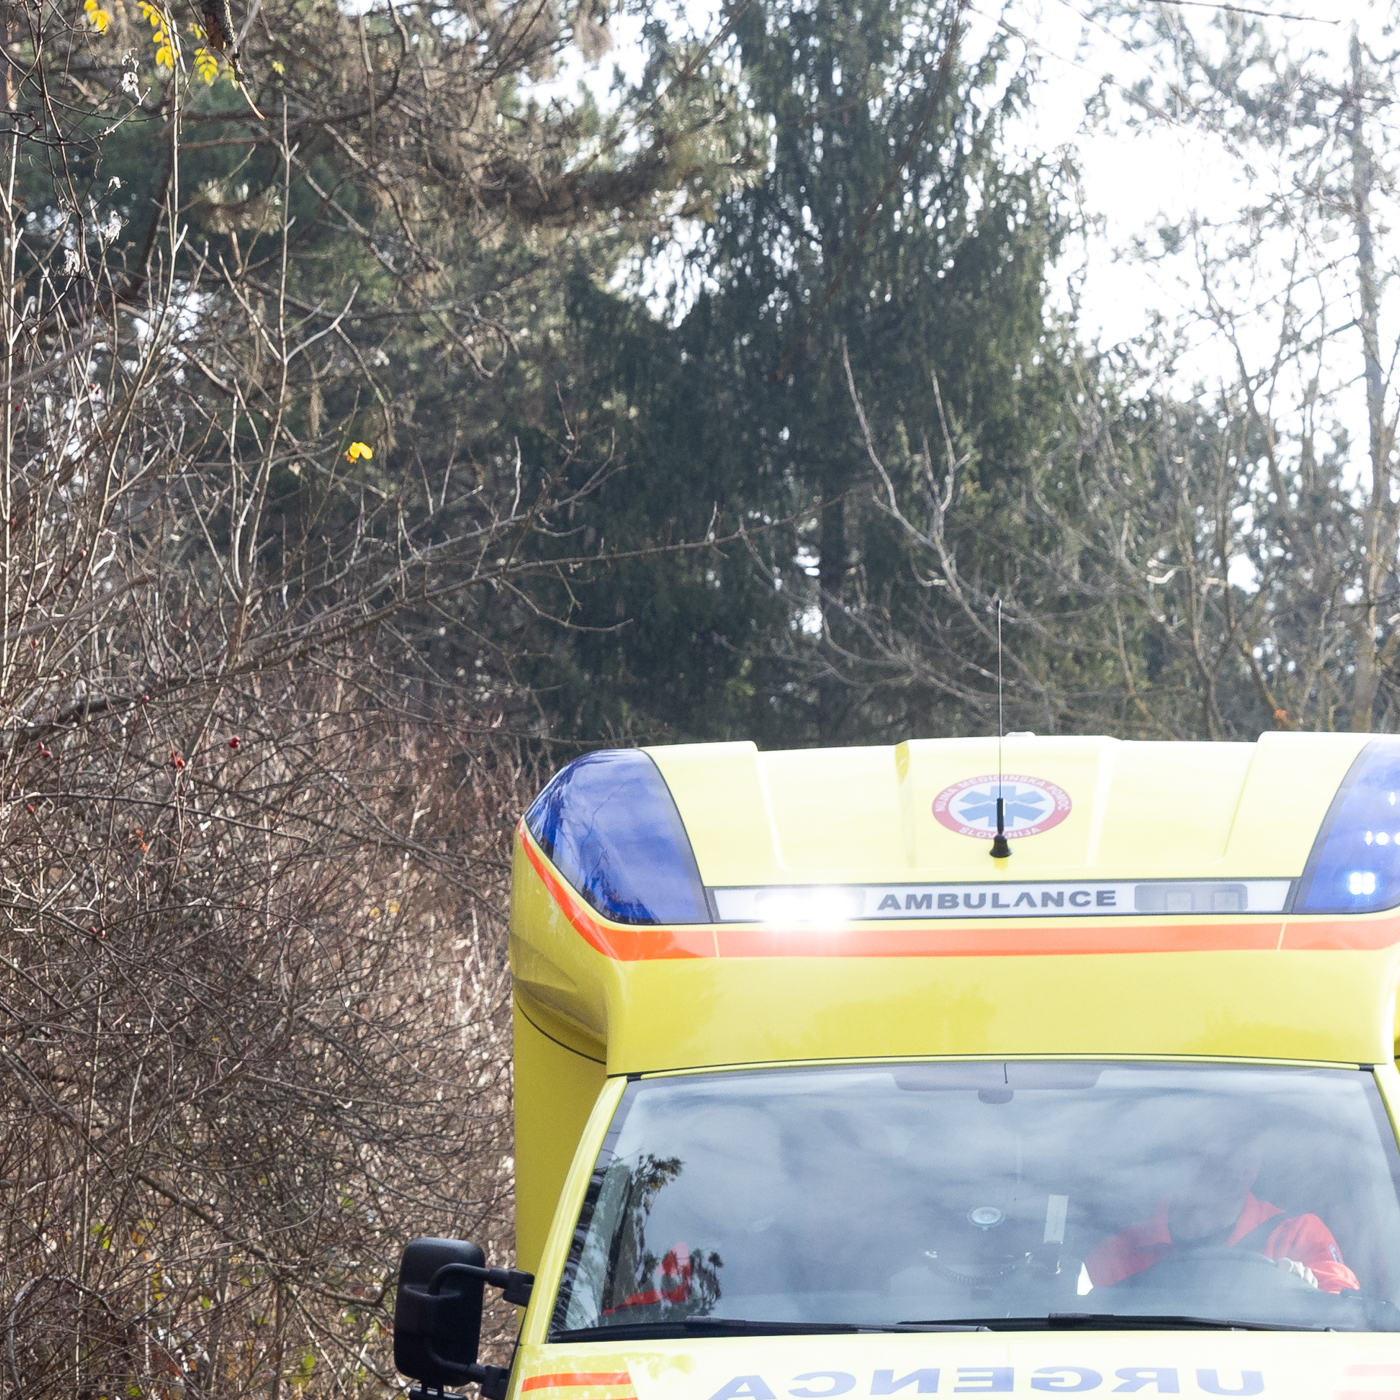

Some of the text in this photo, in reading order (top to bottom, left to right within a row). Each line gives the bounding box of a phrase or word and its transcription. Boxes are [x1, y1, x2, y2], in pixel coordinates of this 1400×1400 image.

[958, 774, 1046, 789] MEDICINSKA
[958, 826, 1042, 839] SLOVNIJA
[876, 889, 1118, 911] AMBULANCE
